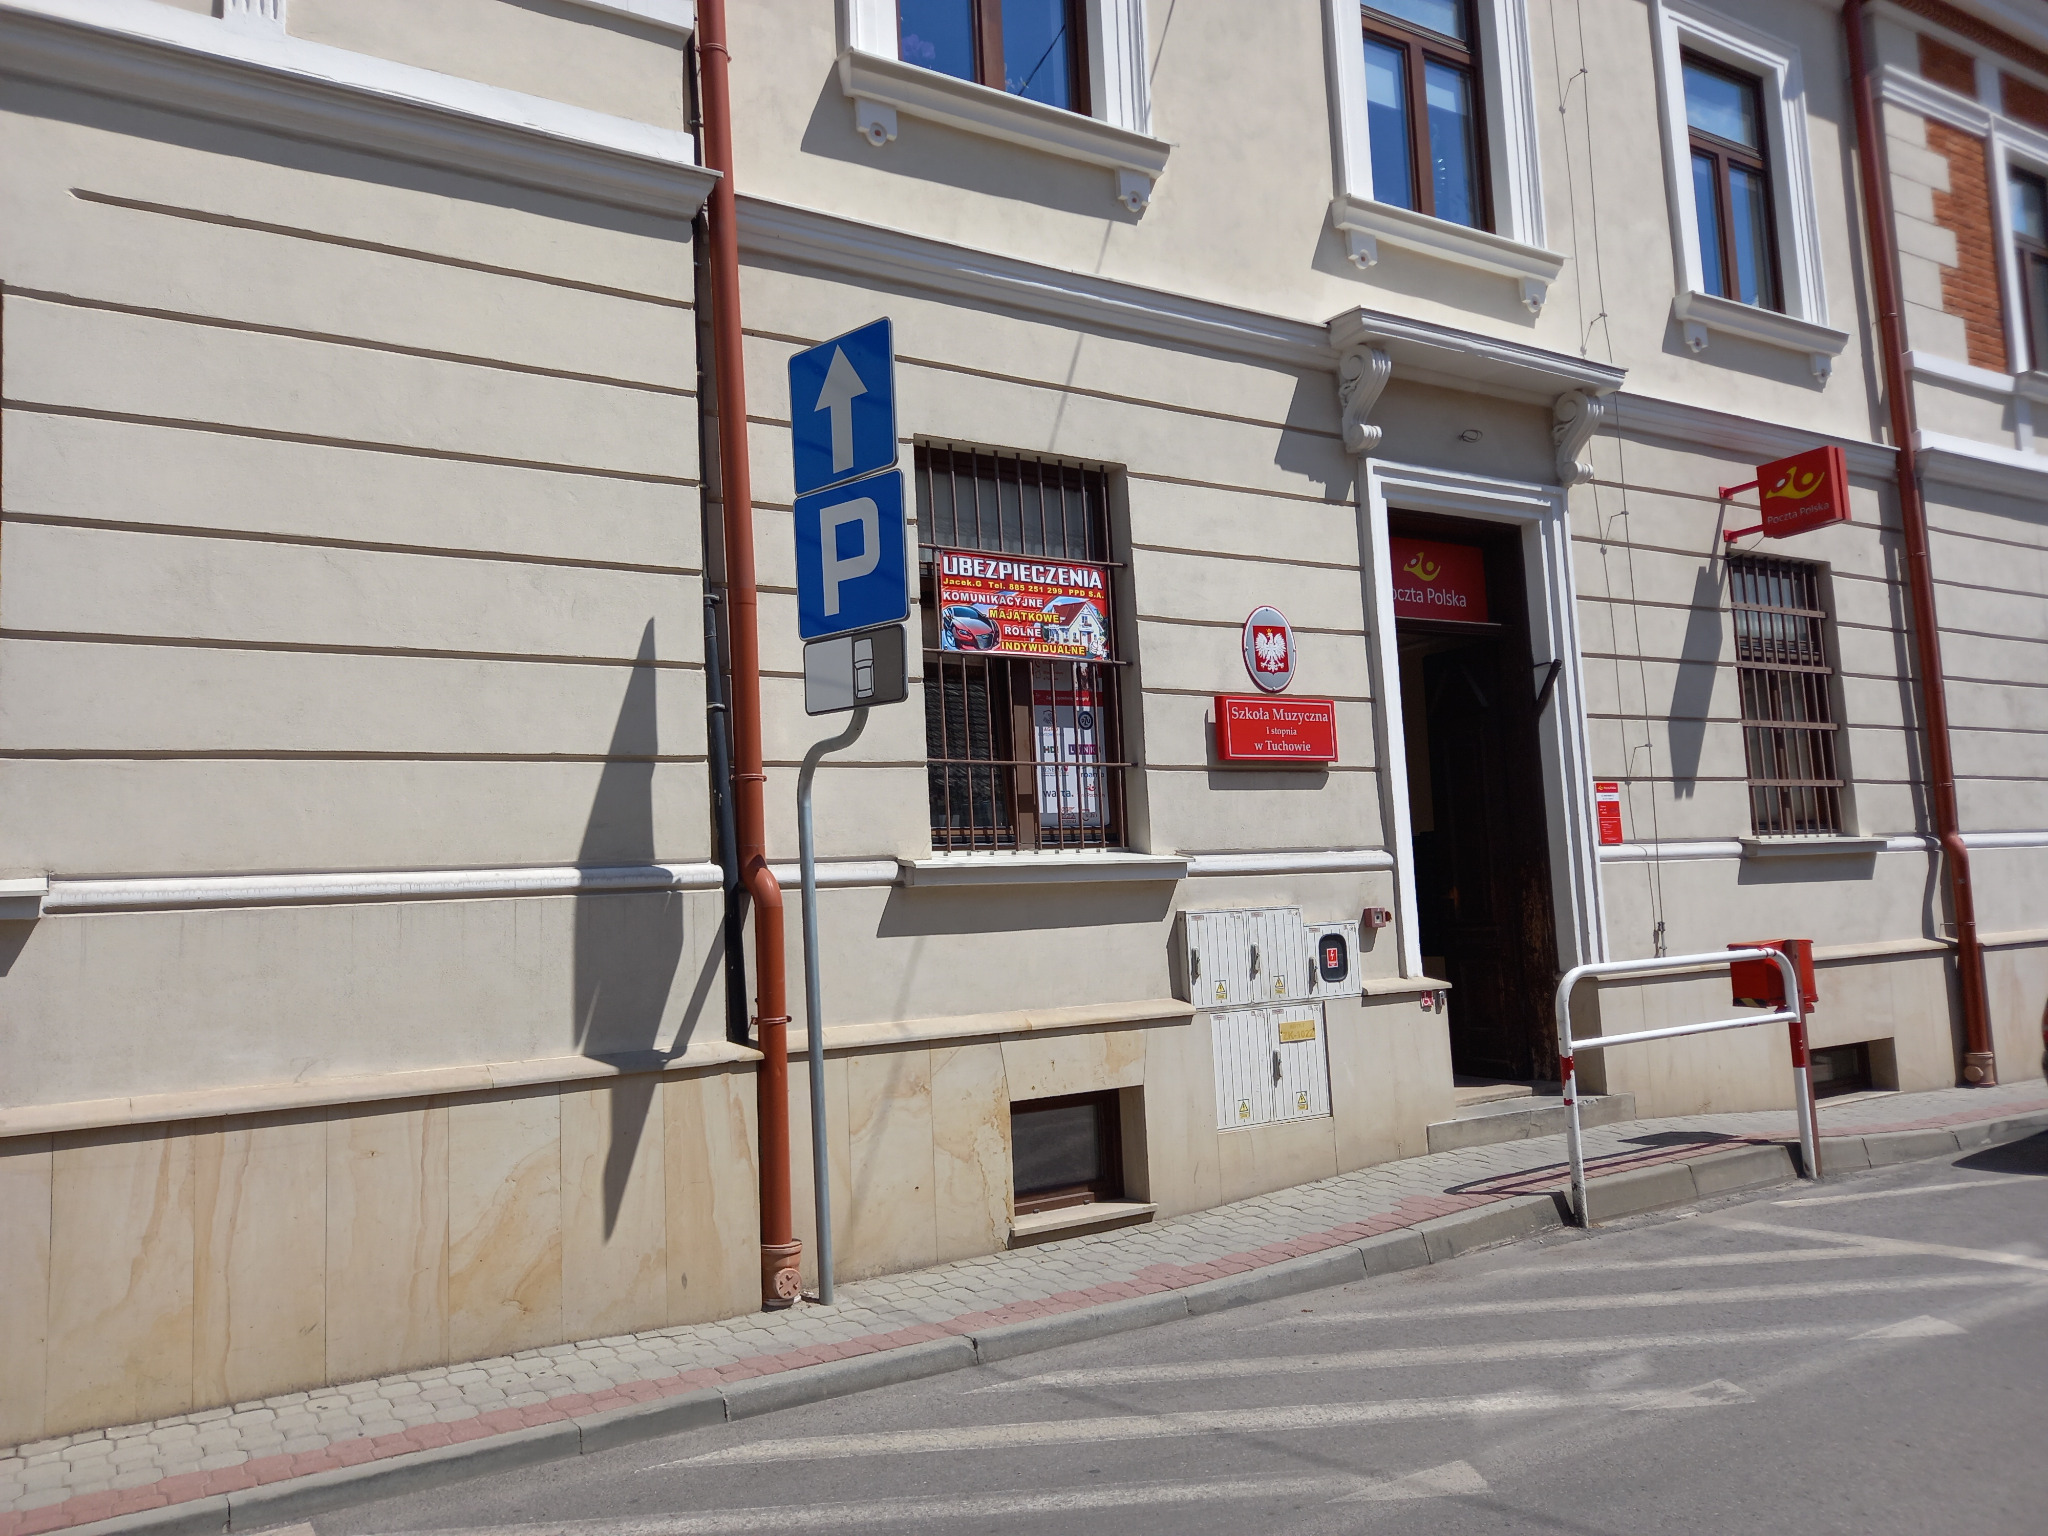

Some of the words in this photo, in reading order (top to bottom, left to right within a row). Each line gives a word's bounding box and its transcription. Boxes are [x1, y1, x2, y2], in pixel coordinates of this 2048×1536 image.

[1767, 511, 1798, 524] Poczta
[1800, 502, 1830, 515] Polska
[820, 497, 880, 616] P
[943, 556, 1103, 590] UBEZPIECZENIA
[988, 581, 1006, 590] Tel.
[1009, 584, 1025, 592] 885
[1028, 585, 1044, 593] 251
[1068, 589, 1086, 597] PPD
[1088, 590, 1105, 599] S.A.
[1392, 587, 1424, 603] oczta
[1427, 588, 1467, 608] Polska
[943, 591, 1044, 608] KOMUNIKACYJNE
[989, 609, 1060, 623] MAJĄTKOWE
[1004, 626, 1042, 637] ROLNE
[1001, 641, 1086, 655] INDYWIDUALNE
[1231, 706, 1270, 720] Szkoła
[1272, 708, 1329, 725] Muzyczna
[1271, 727, 1298, 738] stopnia
[1254, 742, 1263, 751] w
[1265, 740, 1311, 752] Tuchowie
[1043, 790, 1074, 798] wata.
